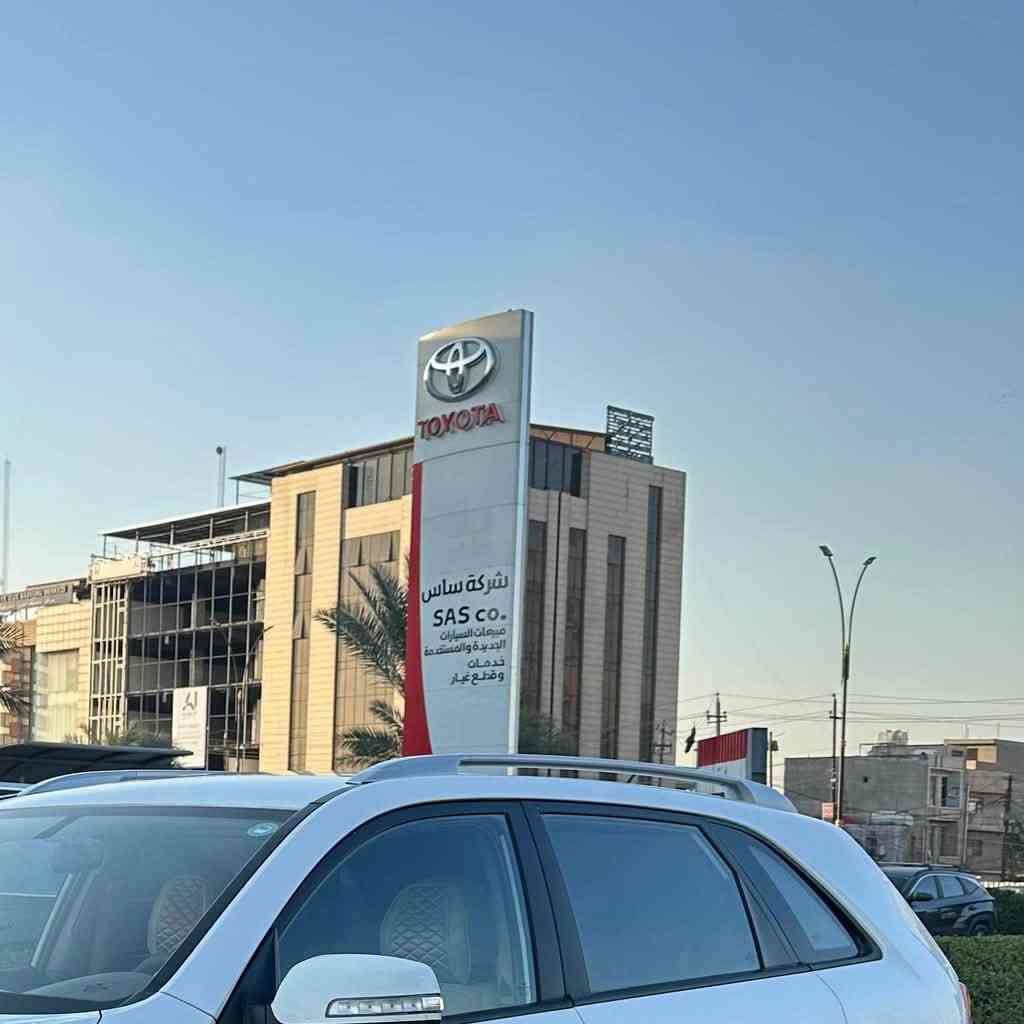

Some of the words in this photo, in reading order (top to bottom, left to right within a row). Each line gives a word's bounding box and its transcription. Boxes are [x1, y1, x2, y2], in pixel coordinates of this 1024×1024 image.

[417, 402, 505, 440] TOYOTA
[422, 578, 463, 603] ساس
[465, 571, 509, 595] شركة
[432, 605, 470, 627] SAS
[467, 656, 505, 669] خدمات
